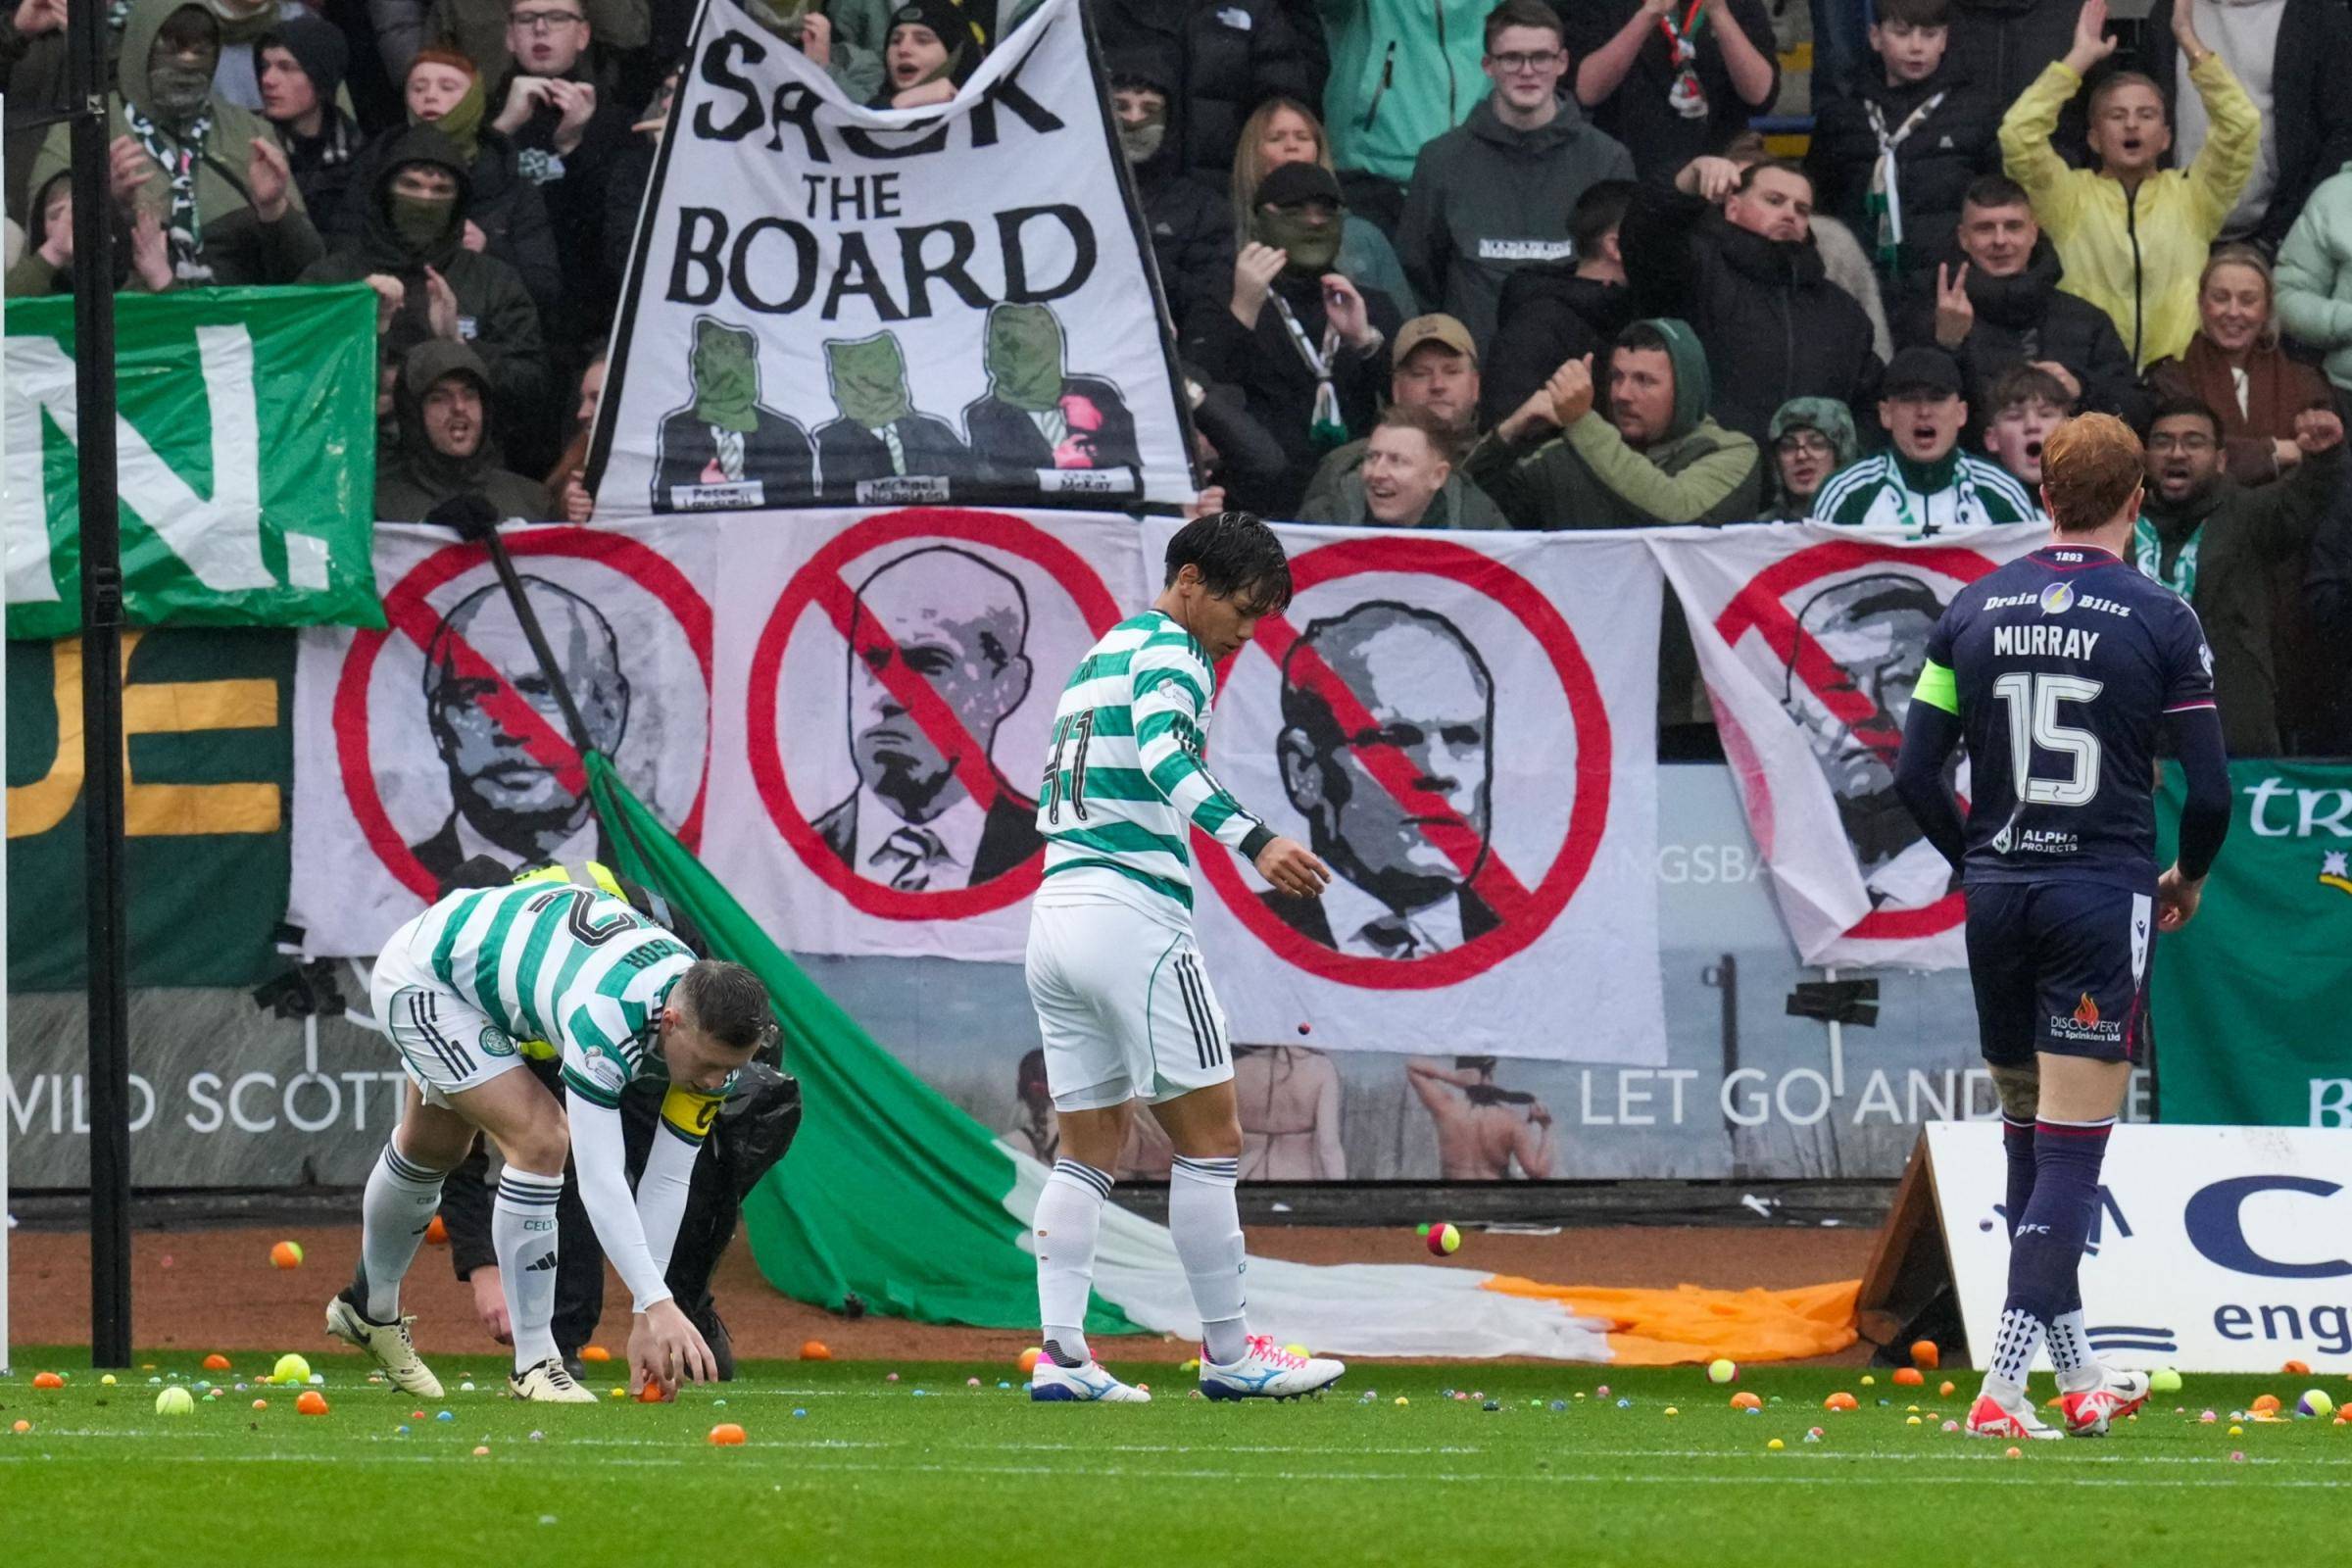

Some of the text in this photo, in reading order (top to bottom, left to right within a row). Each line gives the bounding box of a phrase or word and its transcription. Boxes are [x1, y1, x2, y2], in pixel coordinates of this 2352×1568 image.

[802, 172, 902, 222] THE
[664, 203, 1098, 321] BOARD
[2054, 551, 2084, 563] 1893
[1983, 592, 2132, 617] Drain Blitz
[1994, 625, 2100, 662] MURRAY
[1993, 671, 2105, 808] 15
[2020, 842, 2079, 855] PROJECTS
[2023, 829, 2079, 843] ALPHA
[2050, 1015, 2122, 1034] DISCOVERY
[2065, 1029, 2106, 1041] Sprinklers
[2107, 1032, 2122, 1042] Ltd
[1581, 1068, 1698, 1125] LET
[1720, 1067, 1832, 1126] GO
[1853, 1068, 2003, 1125] AND
